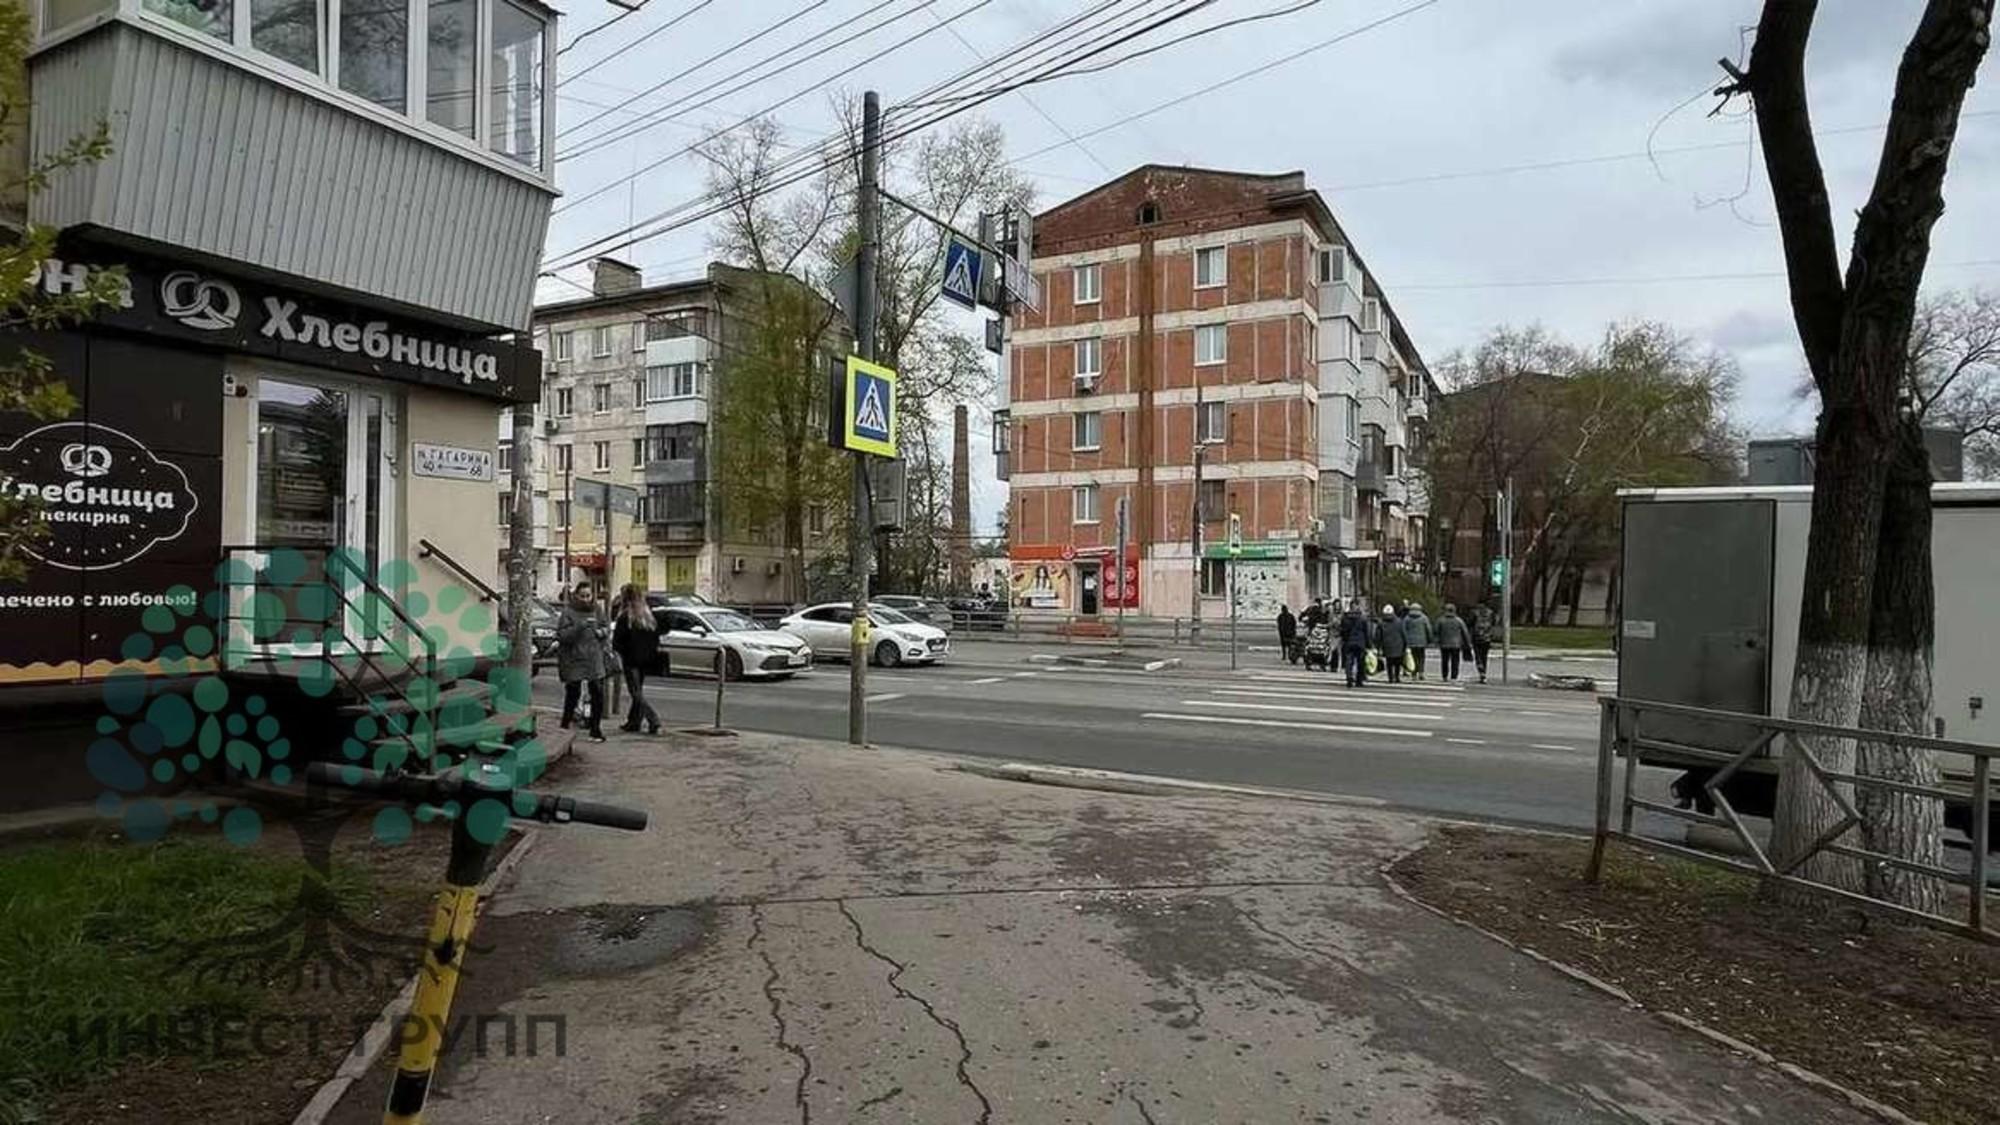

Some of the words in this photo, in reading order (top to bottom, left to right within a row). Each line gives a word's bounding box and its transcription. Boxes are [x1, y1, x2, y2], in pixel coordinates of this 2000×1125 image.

[260, 296, 498, 384] Хлебница
[40, 510, 131, 527] пекарня
[83, 594, 93, 607] с
[99, 591, 197, 608] любовью!
